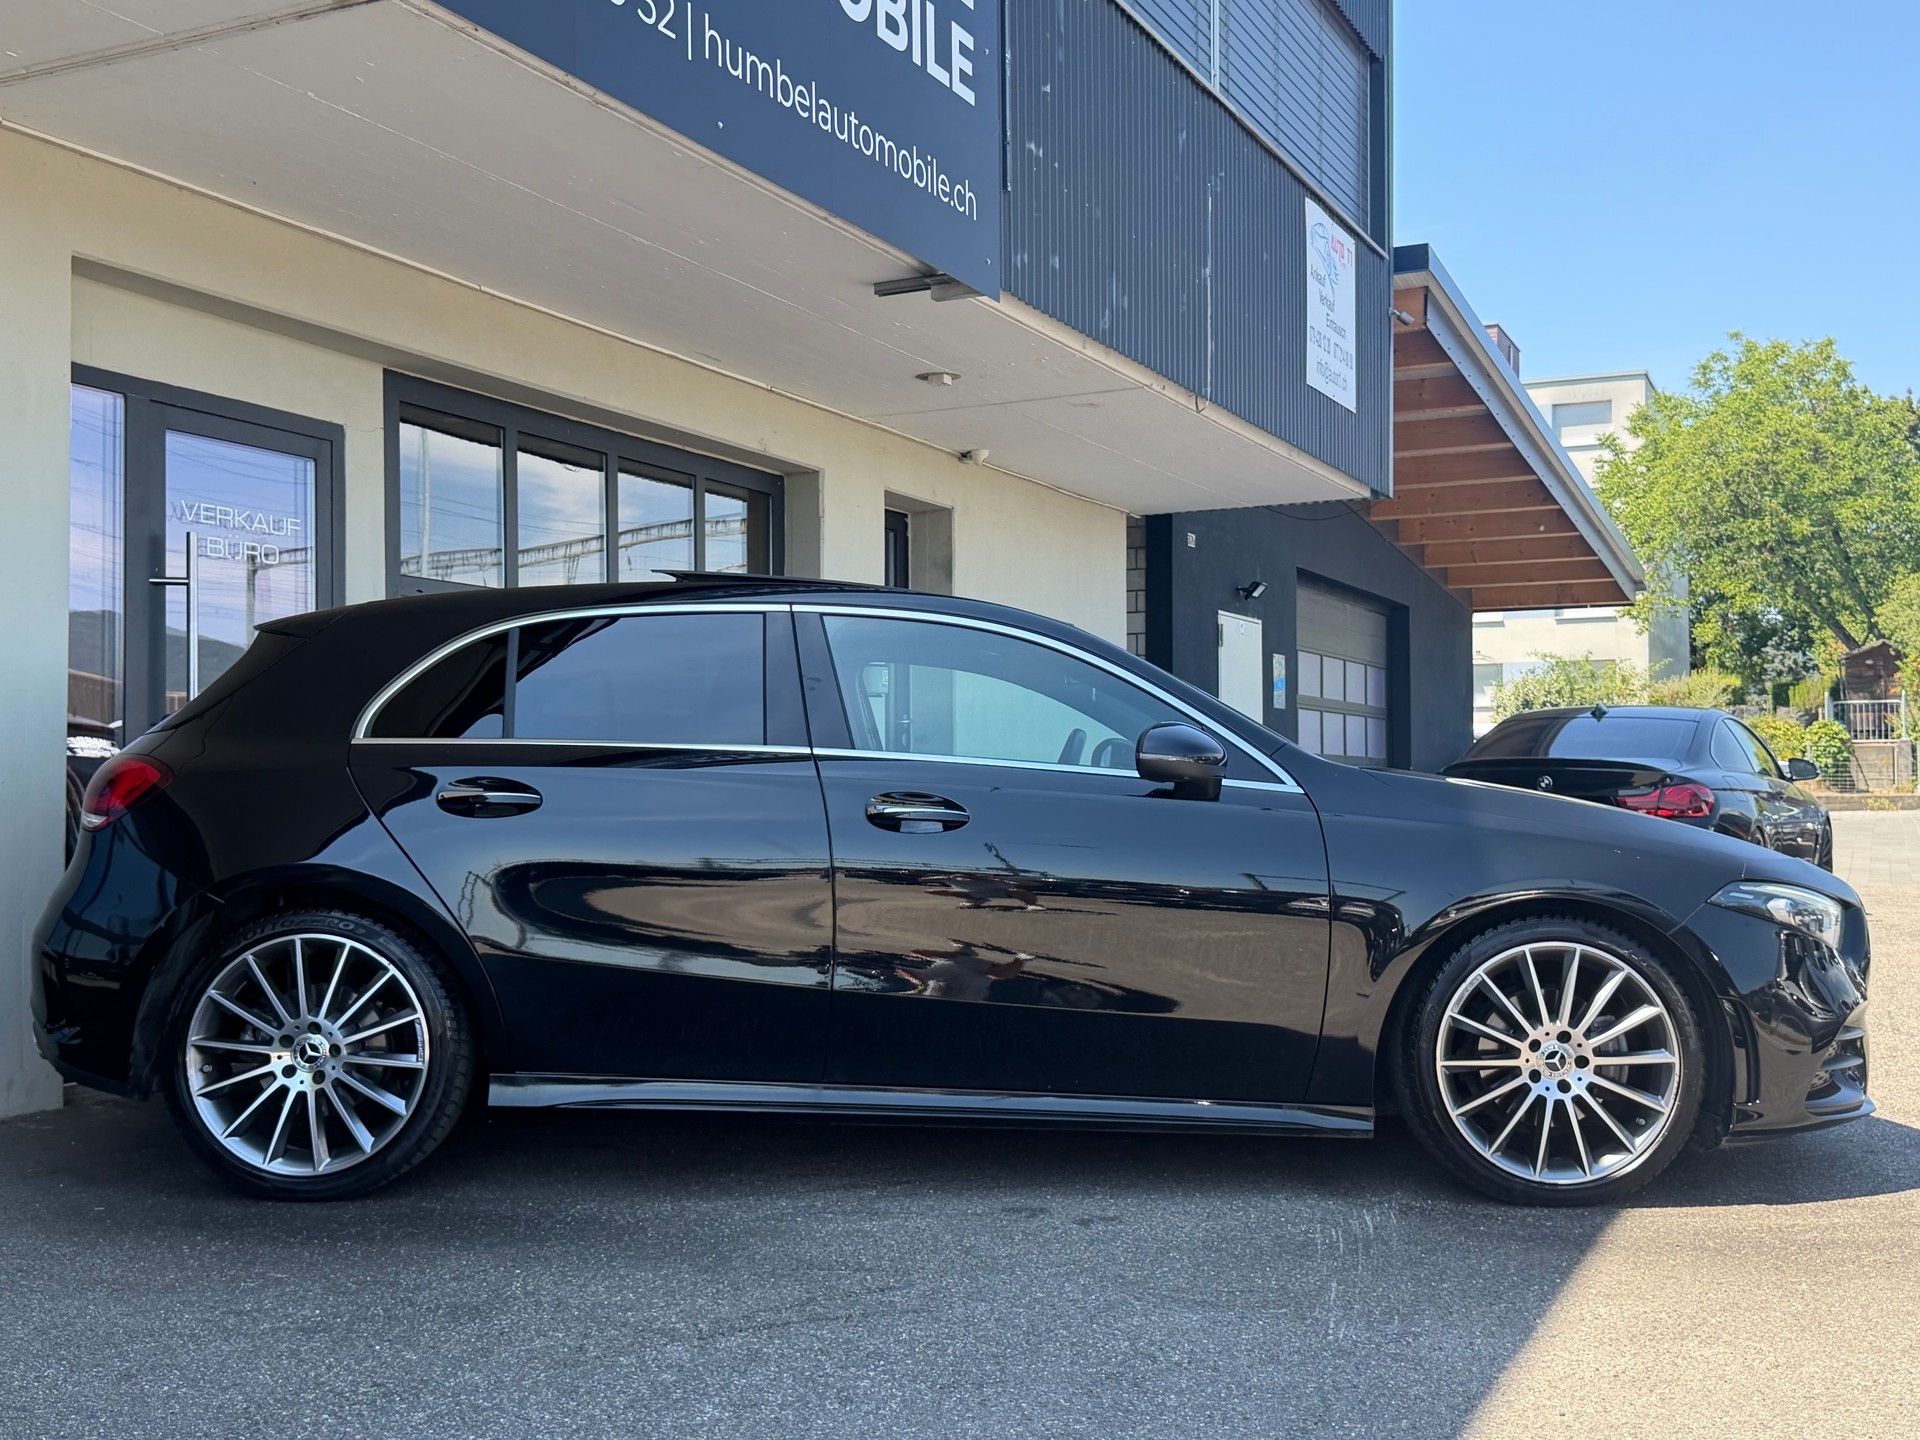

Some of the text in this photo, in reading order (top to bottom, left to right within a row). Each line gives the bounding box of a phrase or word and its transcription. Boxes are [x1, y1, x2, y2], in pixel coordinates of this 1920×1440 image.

[839, 0, 976, 107] BILE
[704, 12, 978, 221] humbelautomobile.ch
[1319, 288, 1336, 313] Verkauf
[181, 499, 301, 536] VERKAUF
[207, 534, 280, 566] BÜRO
